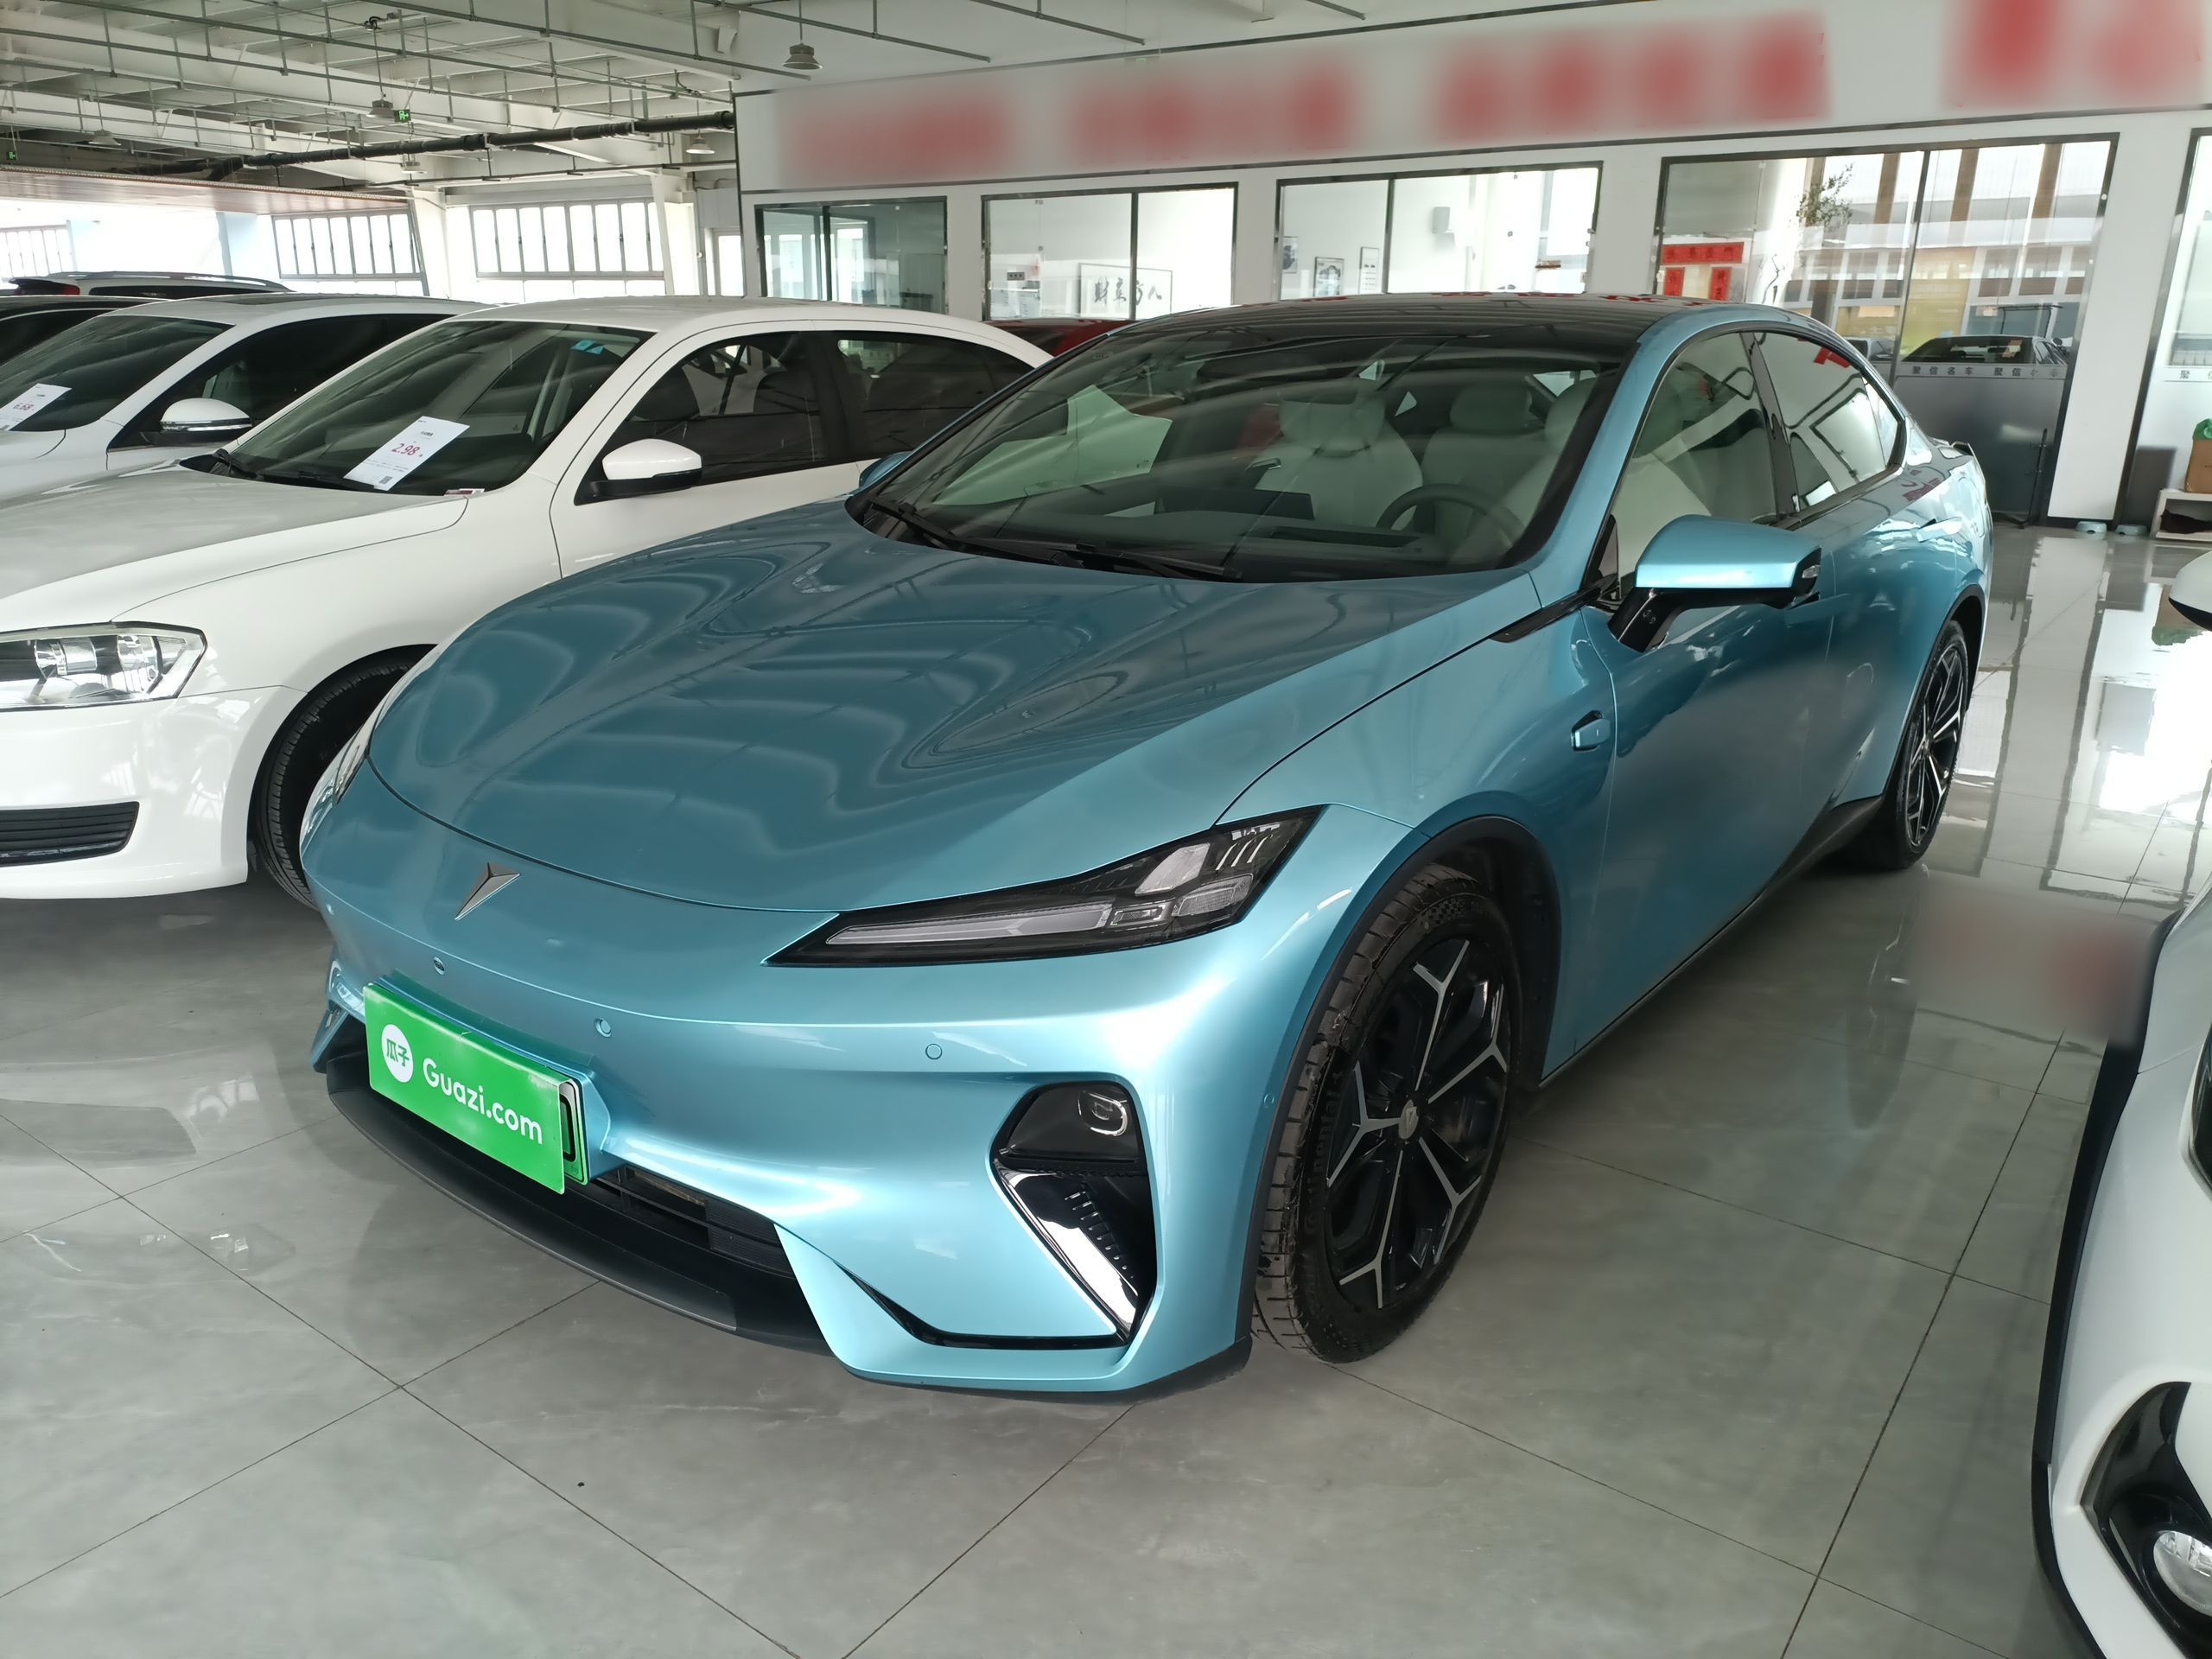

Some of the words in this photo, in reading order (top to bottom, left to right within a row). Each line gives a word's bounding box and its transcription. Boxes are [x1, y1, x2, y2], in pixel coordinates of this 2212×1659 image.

[391, 442, 420, 456] 2.98
[386, 1039, 410, 1067] 瓜子
[423, 1057, 543, 1145] Guazi.com
